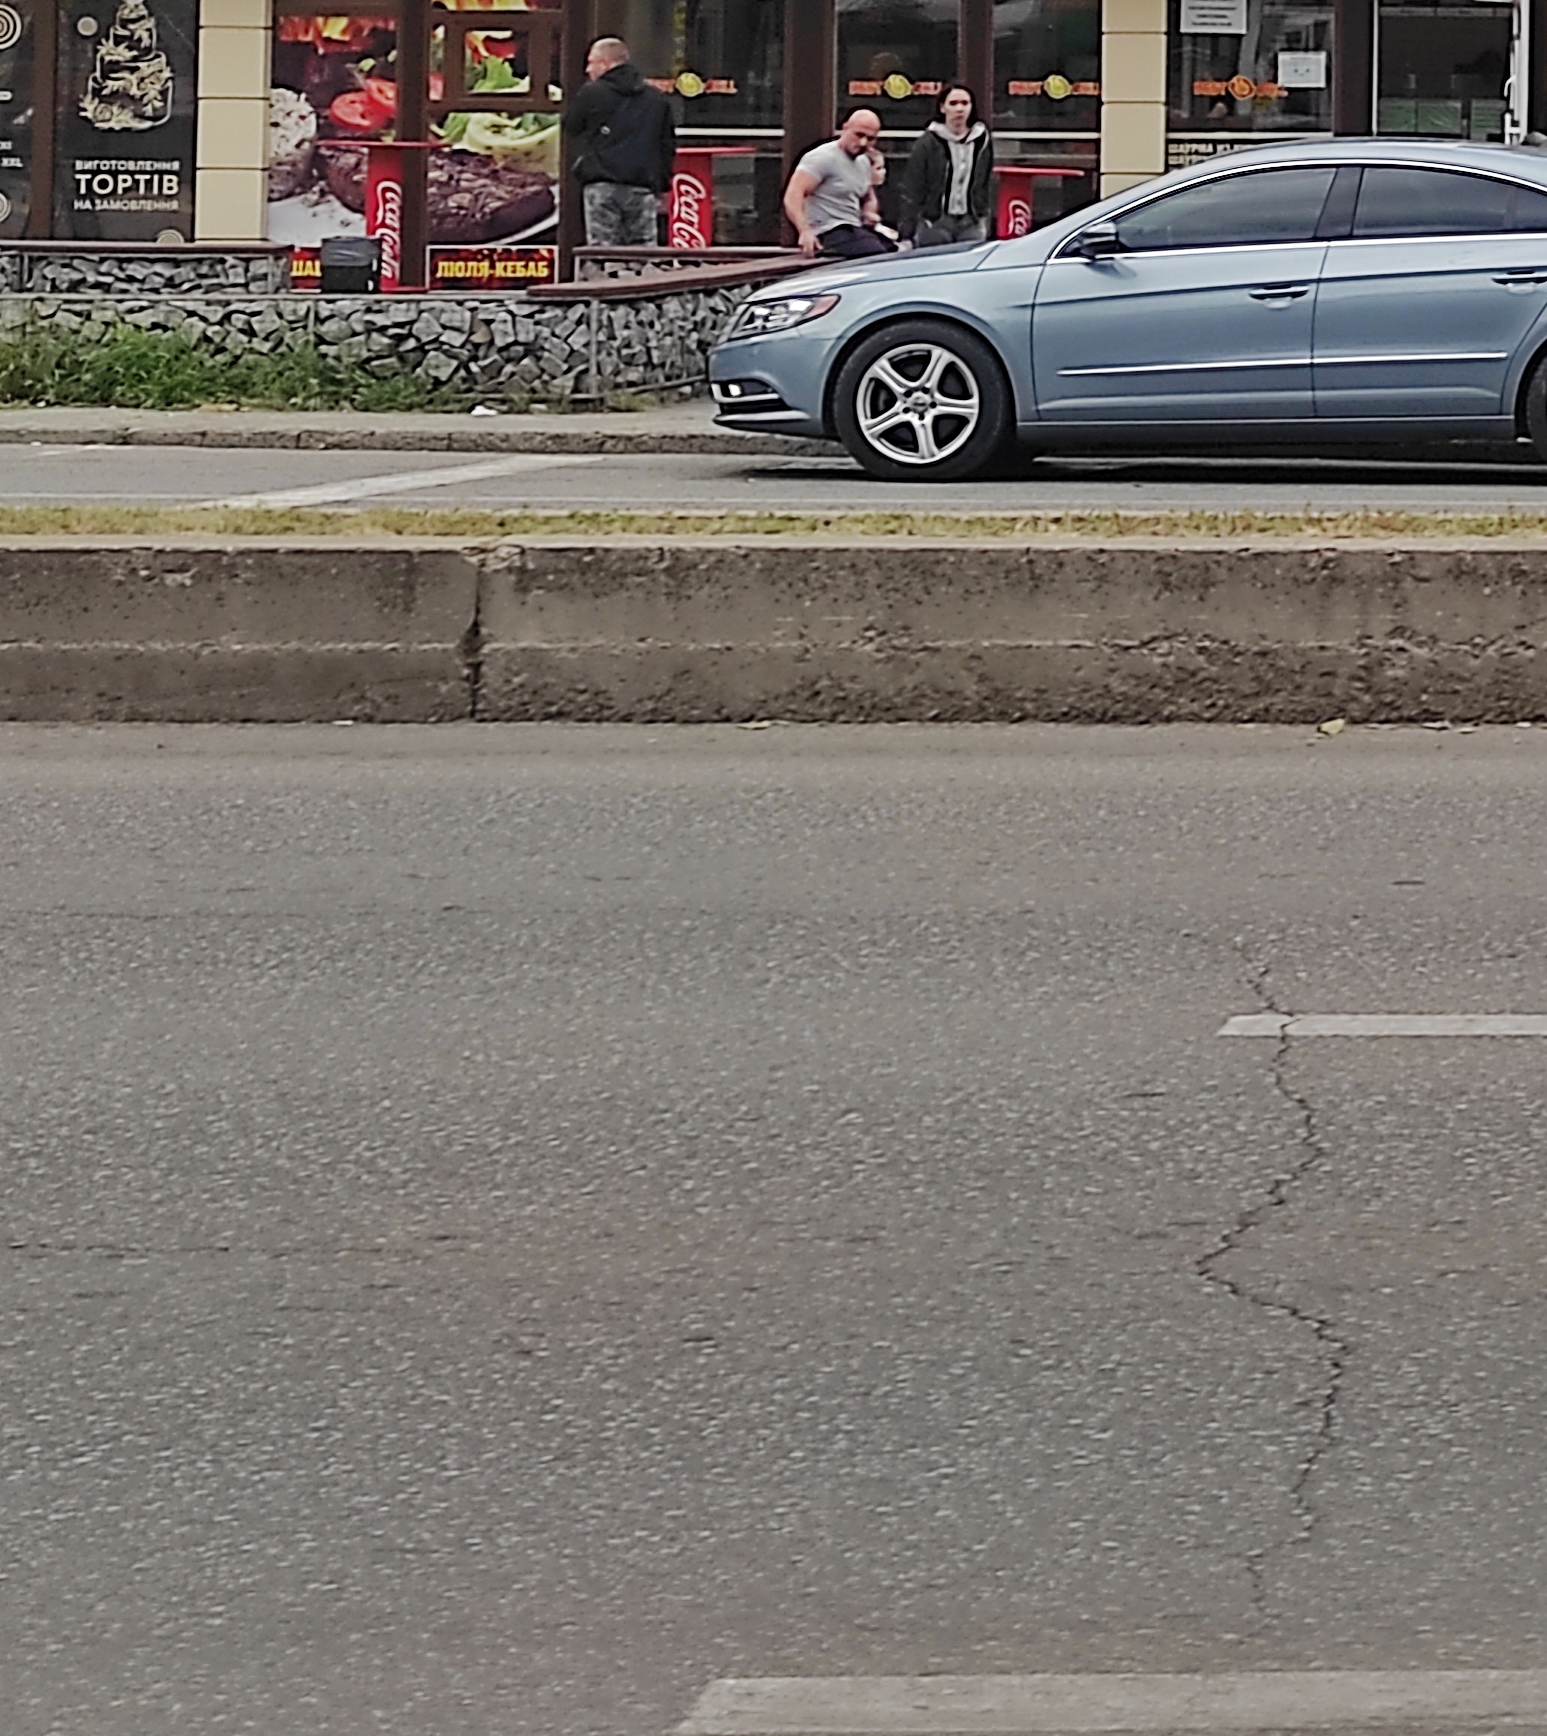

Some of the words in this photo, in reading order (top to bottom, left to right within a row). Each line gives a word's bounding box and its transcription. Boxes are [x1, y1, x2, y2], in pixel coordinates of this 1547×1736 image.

[74, 173, 179, 195] ТОРТІВ
[74, 199, 93, 211] НА
[435, 260, 549, 278] ЛЮЛЯ-КЕБАБ
